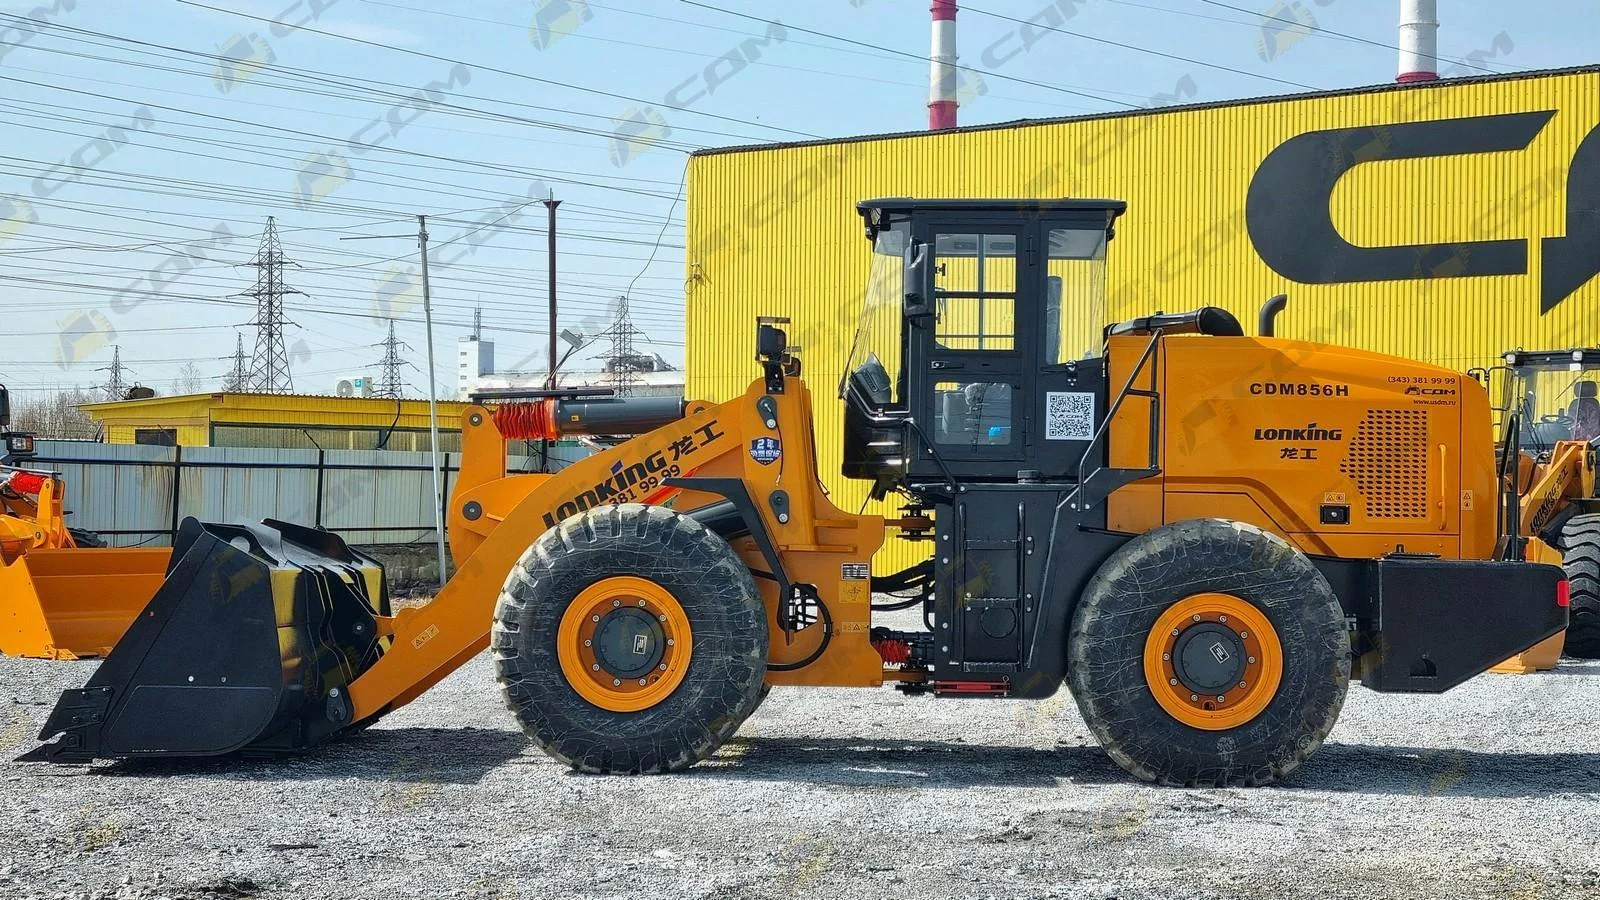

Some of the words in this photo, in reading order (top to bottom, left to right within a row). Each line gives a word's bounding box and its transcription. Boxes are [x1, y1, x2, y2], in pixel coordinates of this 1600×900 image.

[1387, 375, 1410, 384] (343)
[1412, 376, 1428, 384] 381
[1430, 377, 1442, 385] 99
[1444, 377, 1456, 385] 99
[1249, 382, 1349, 397] CDM856H
[639, 476, 659, 493] 99
[660, 464, 681, 478] 99
